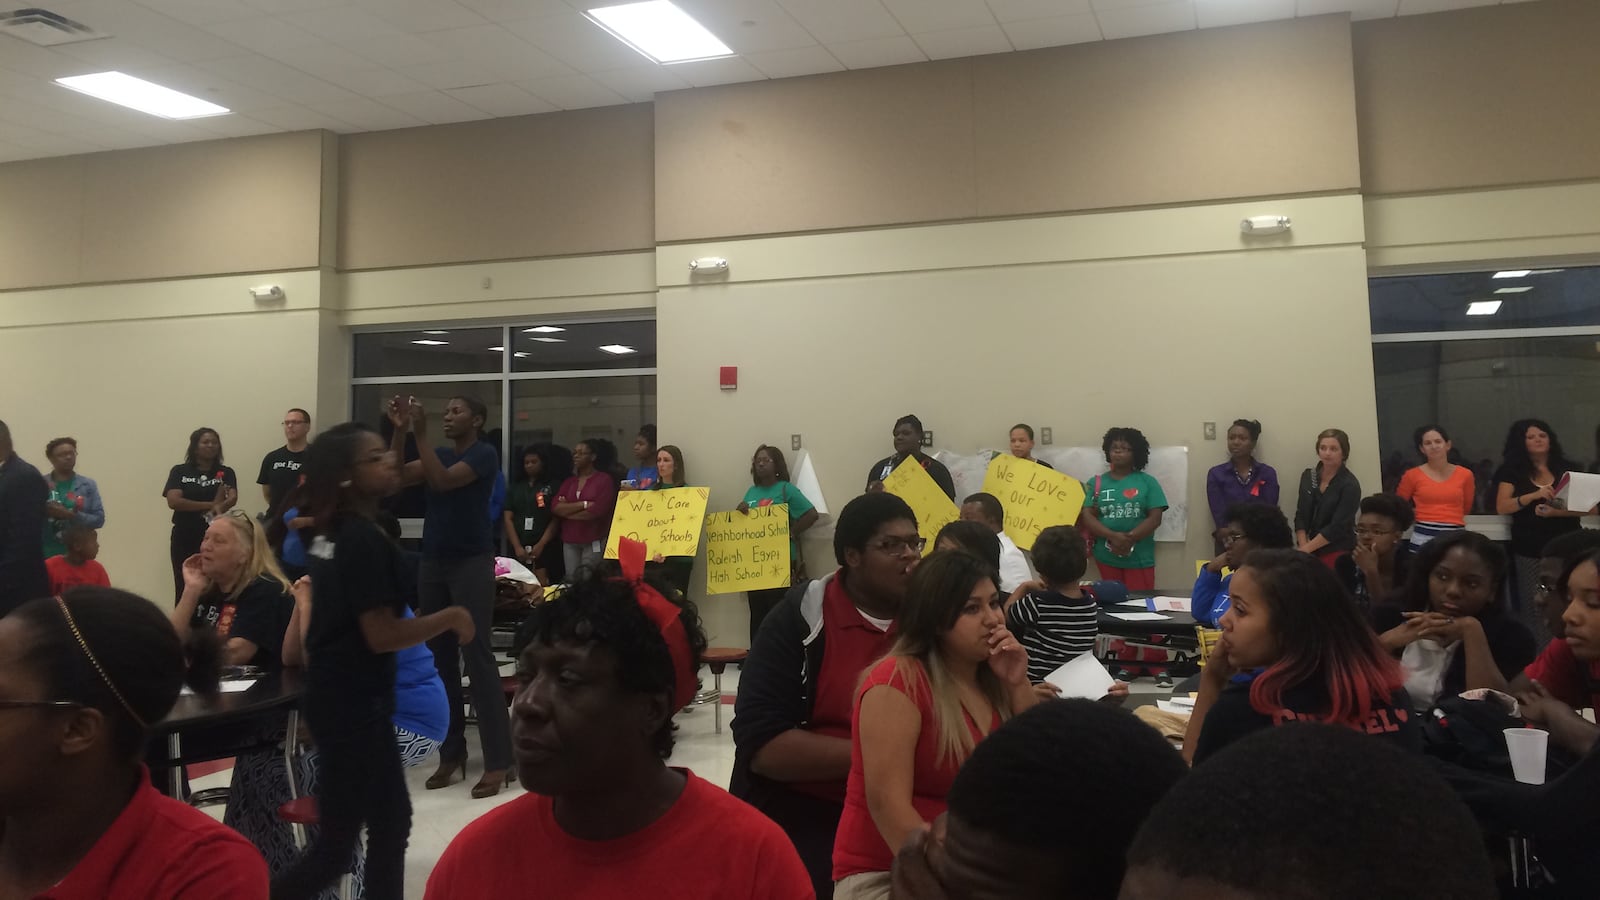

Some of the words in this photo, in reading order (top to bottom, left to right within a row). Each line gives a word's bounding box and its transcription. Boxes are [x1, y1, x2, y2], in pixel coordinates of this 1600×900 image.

[273, 461, 285, 470] got
[182, 475, 195, 483] got
[996, 465, 1014, 483] We
[1102, 489, 1115, 501] I
[629, 499, 653, 511] We
[667, 496, 690, 509] Care
[647, 515, 676, 527] about
[1004, 510, 1041, 537] hools
[660, 529, 693, 543] Schools
[708, 548, 743, 565] Raleigh
[752, 545, 780, 563] Egypt
[710, 570, 729, 583] High
[735, 564, 763, 581] School
